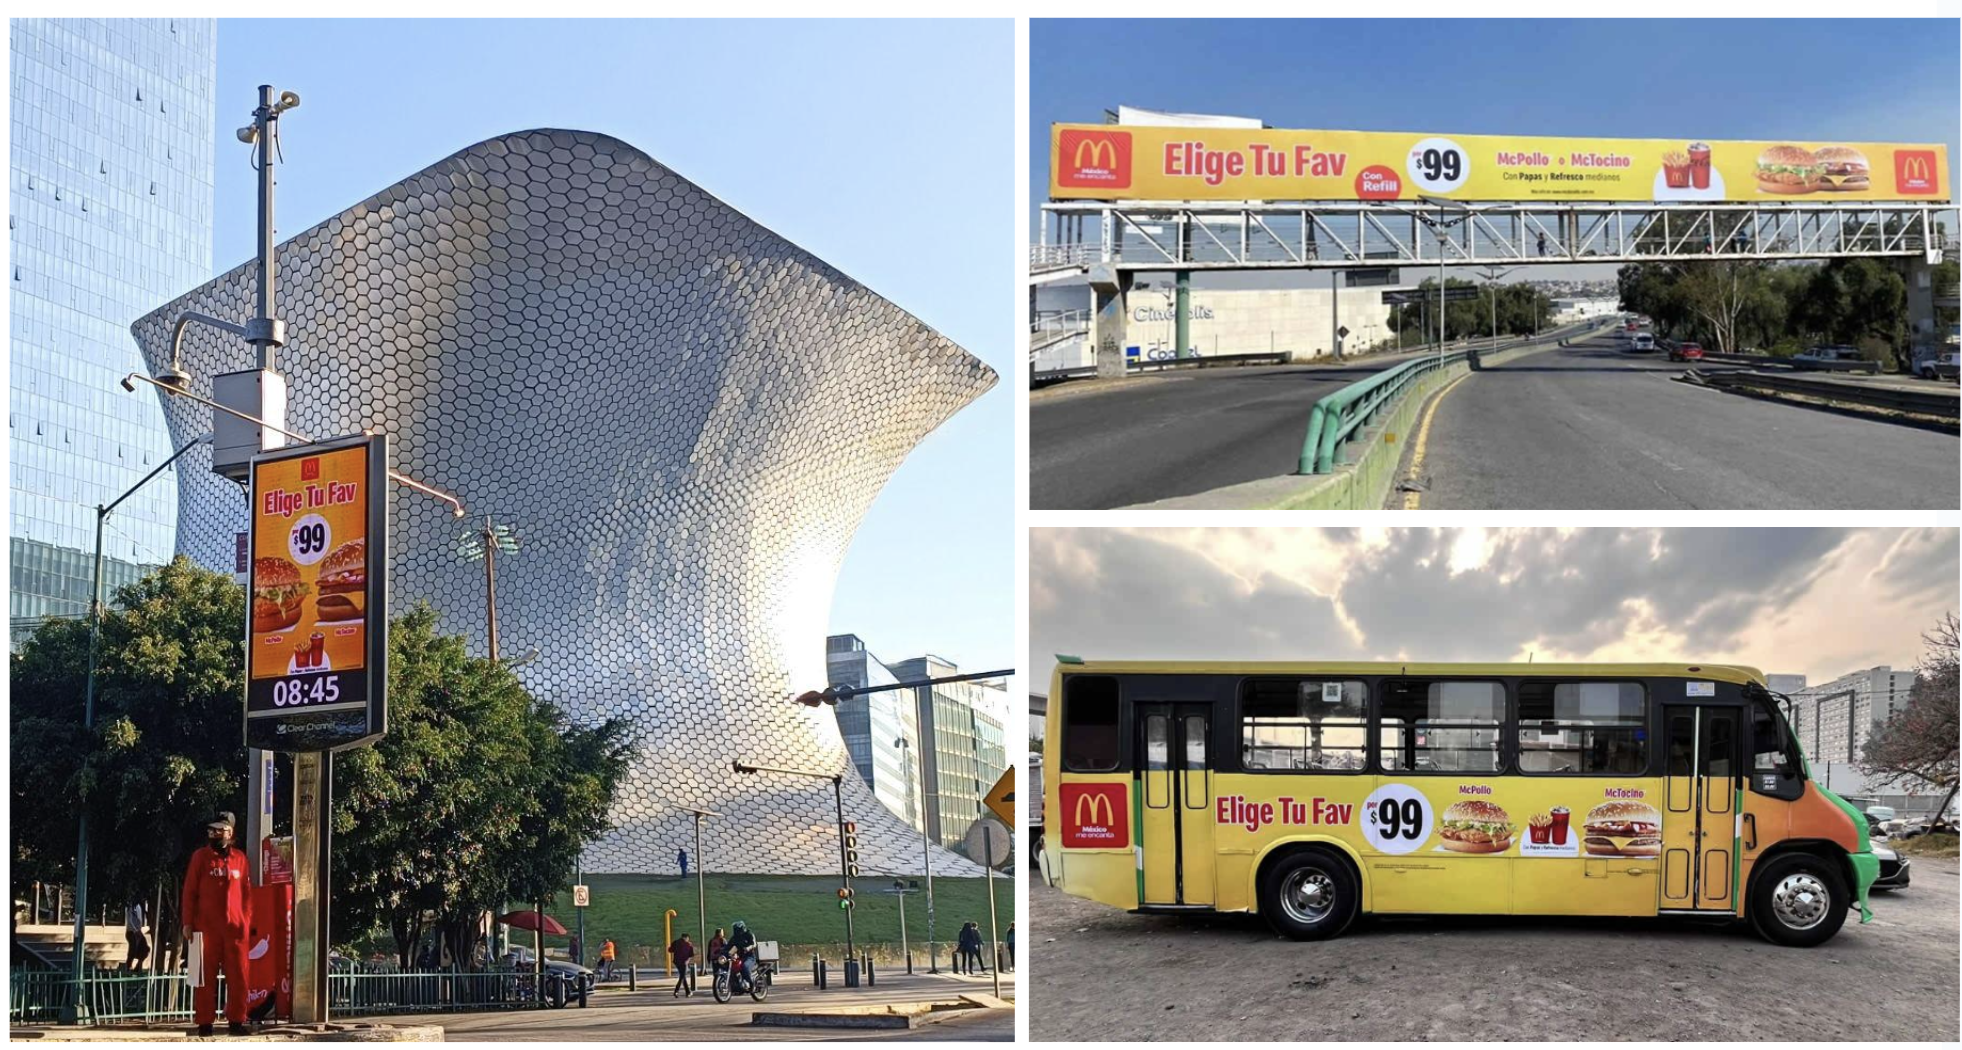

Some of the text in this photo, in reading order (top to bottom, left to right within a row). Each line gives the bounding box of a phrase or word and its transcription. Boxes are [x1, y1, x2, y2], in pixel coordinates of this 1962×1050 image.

[1164, 142, 1347, 185] Elige Tu Fav
[1497, 152, 1630, 167] McPollo o McTocino
[1362, 172, 1382, 180] Con
[1503, 172, 1620, 182] Con Papas y Refresco medianos
[1363, 181, 1398, 192] Refill
[264, 481, 356, 518] Elige Tu Fav
[273, 675, 339, 706] 08:45
[287, 721, 335, 732] Clear Channel
[1459, 785, 1491, 794] McPollo
[1604, 788, 1644, 798] McTocino
[1366, 801, 1377, 810] por
[1216, 796, 1353, 832] Elige Tu Fav
